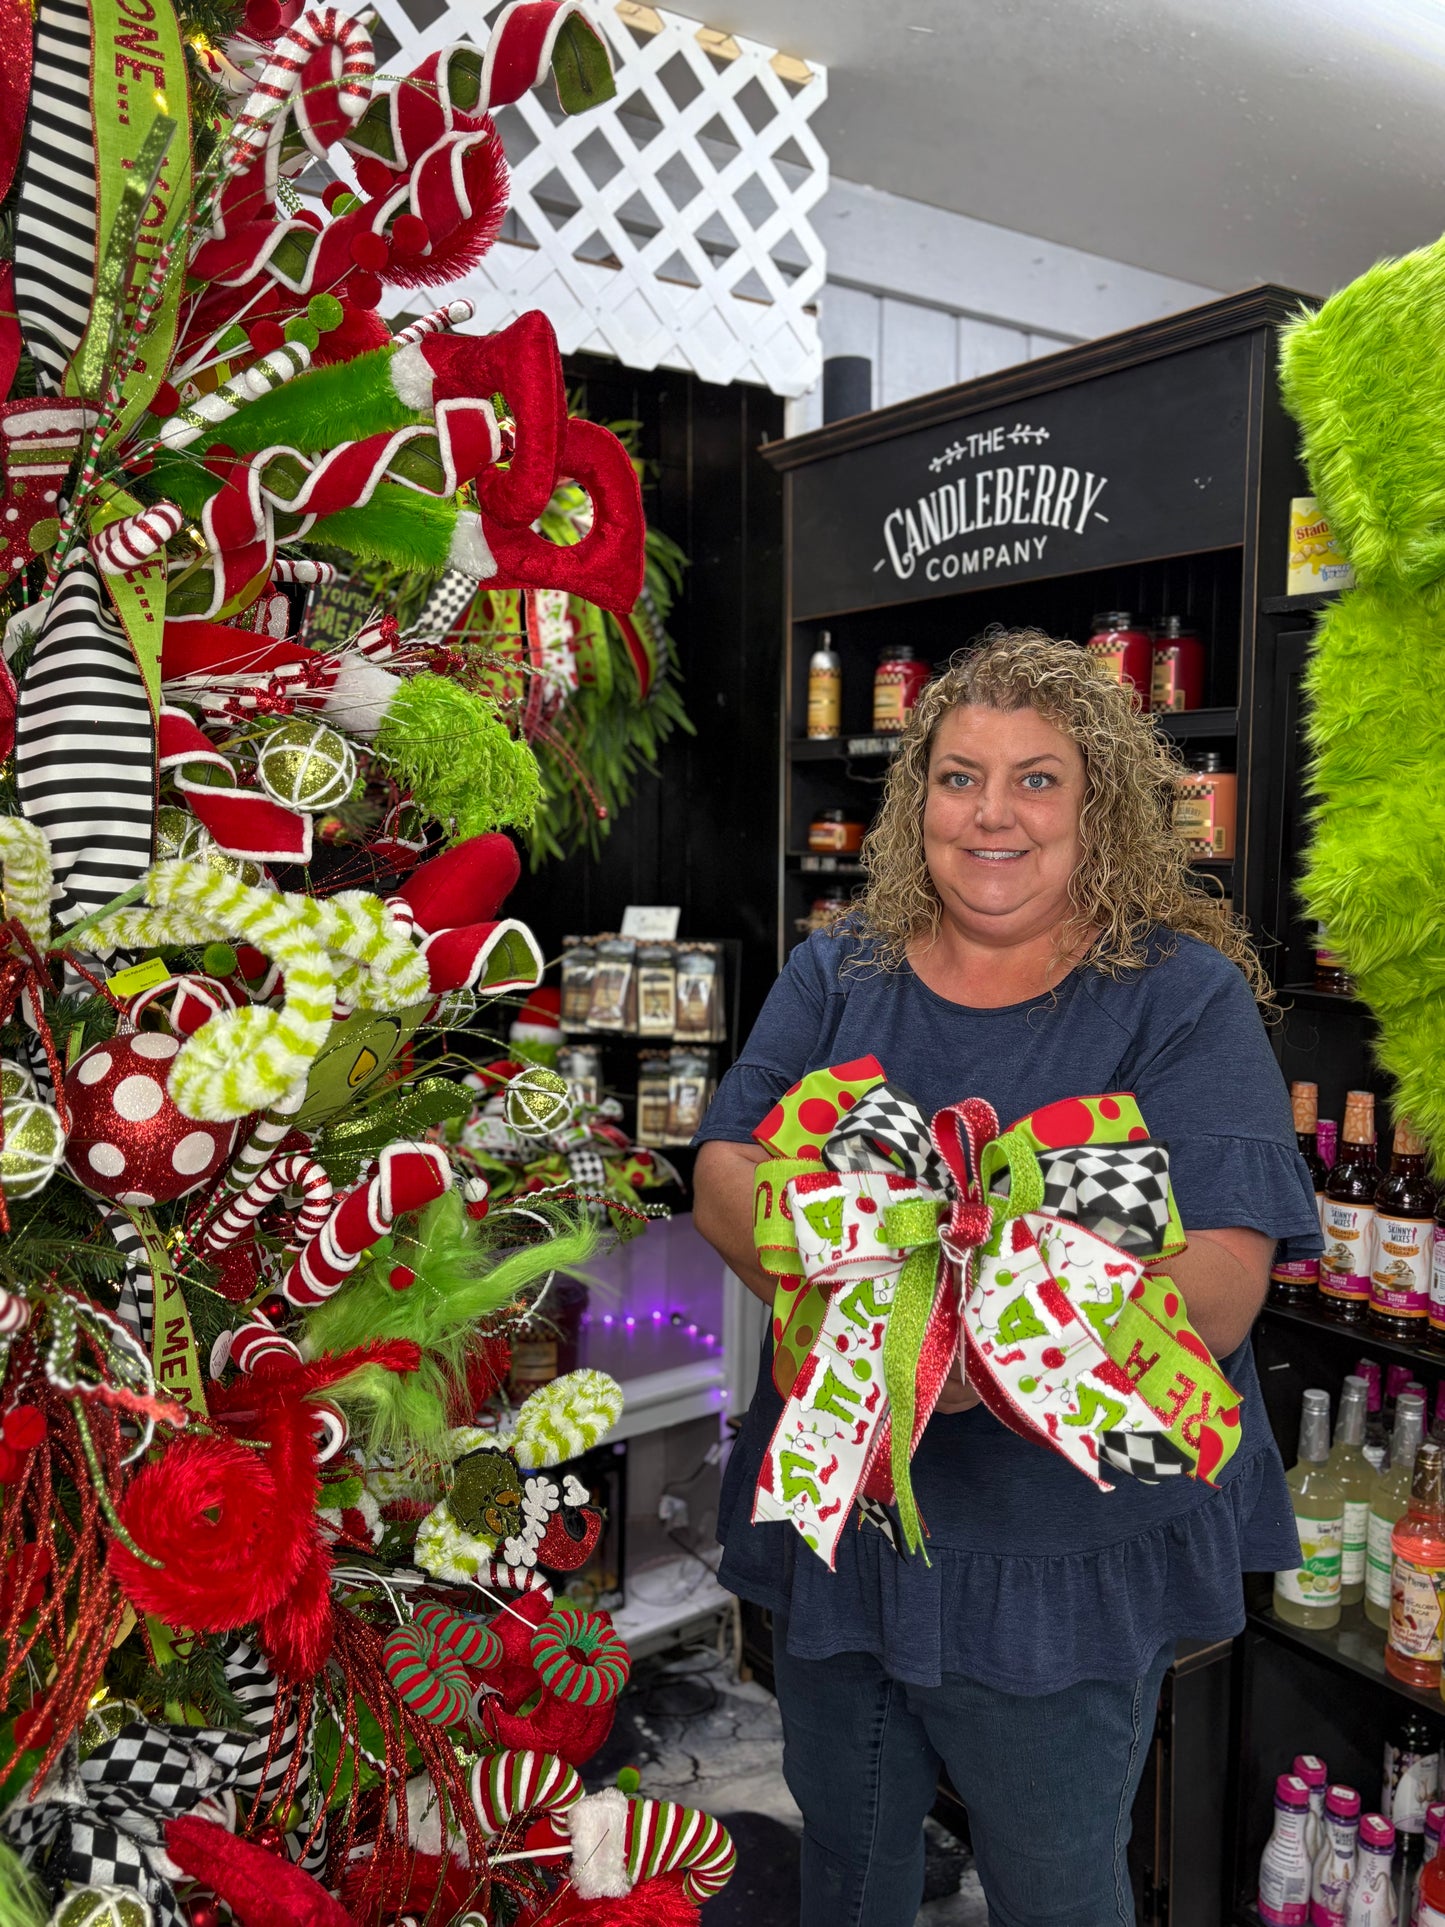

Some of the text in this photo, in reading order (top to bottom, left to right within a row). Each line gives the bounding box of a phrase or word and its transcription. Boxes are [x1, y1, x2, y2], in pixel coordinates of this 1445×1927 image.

[966, 426, 1006, 458] THE
[883, 464, 1108, 580] CANDLEBERRY
[925, 534, 1048, 582] COMPANY
[311, 602, 364, 640] MEA
[1387, 1225, 1411, 1236] SKINNY
[1391, 1233, 1410, 1244] MIXES
